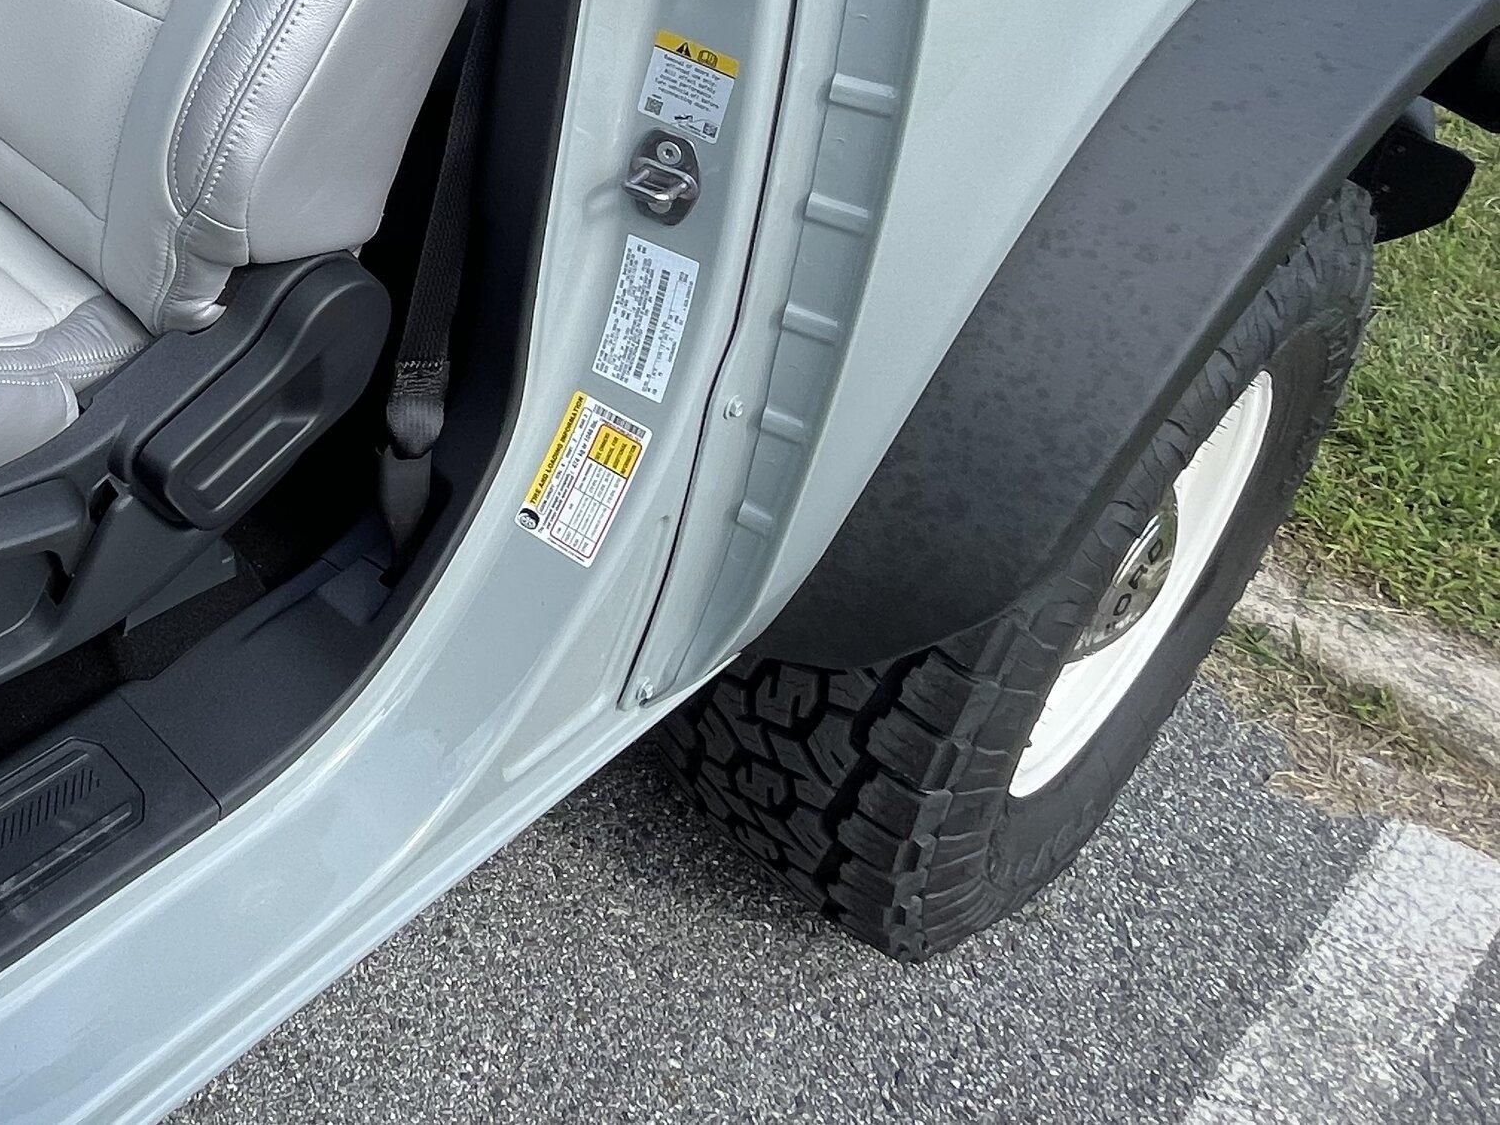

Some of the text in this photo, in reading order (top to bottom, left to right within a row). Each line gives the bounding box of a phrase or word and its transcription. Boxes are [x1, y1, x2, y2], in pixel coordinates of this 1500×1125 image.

[529, 488, 541, 504] TIRE
[537, 472, 549, 488] AND
[544, 442, 563, 473] LOADING
[558, 395, 585, 443] INFORMATION
